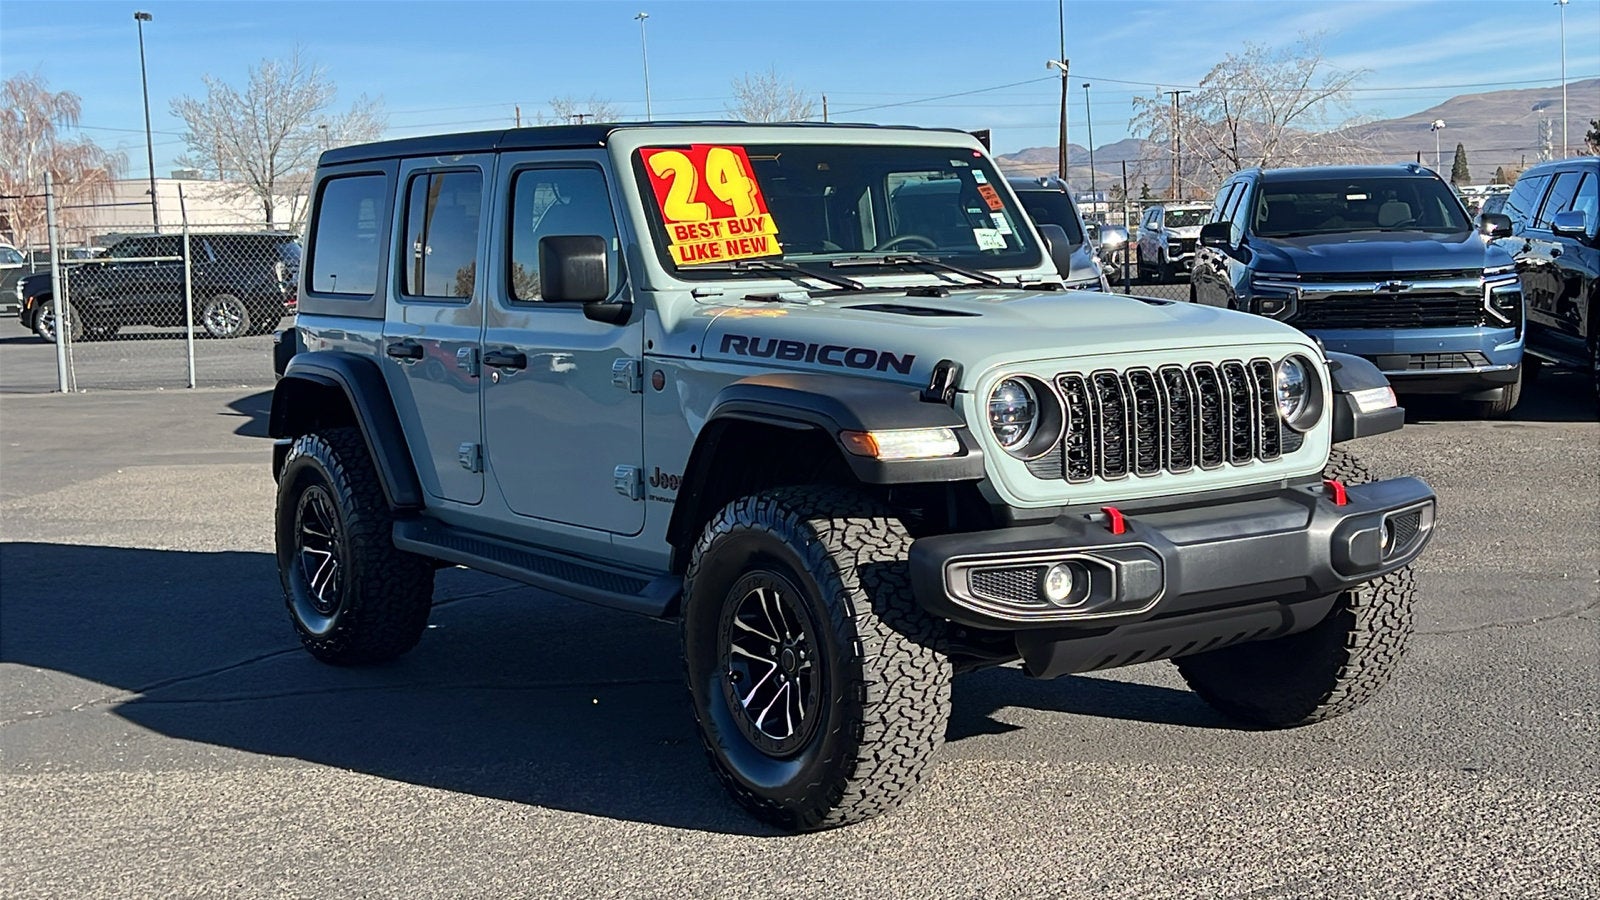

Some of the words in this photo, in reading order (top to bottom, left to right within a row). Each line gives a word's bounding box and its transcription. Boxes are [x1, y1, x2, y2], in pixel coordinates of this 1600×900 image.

[649, 147, 760, 222] 24
[674, 222, 722, 241] BEST
[727, 216, 765, 235] BUY
[679, 241, 721, 262] LIKE
[725, 236, 768, 256] NEW
[719, 333, 916, 375] RUBICON
[649, 466, 684, 491] Jee
